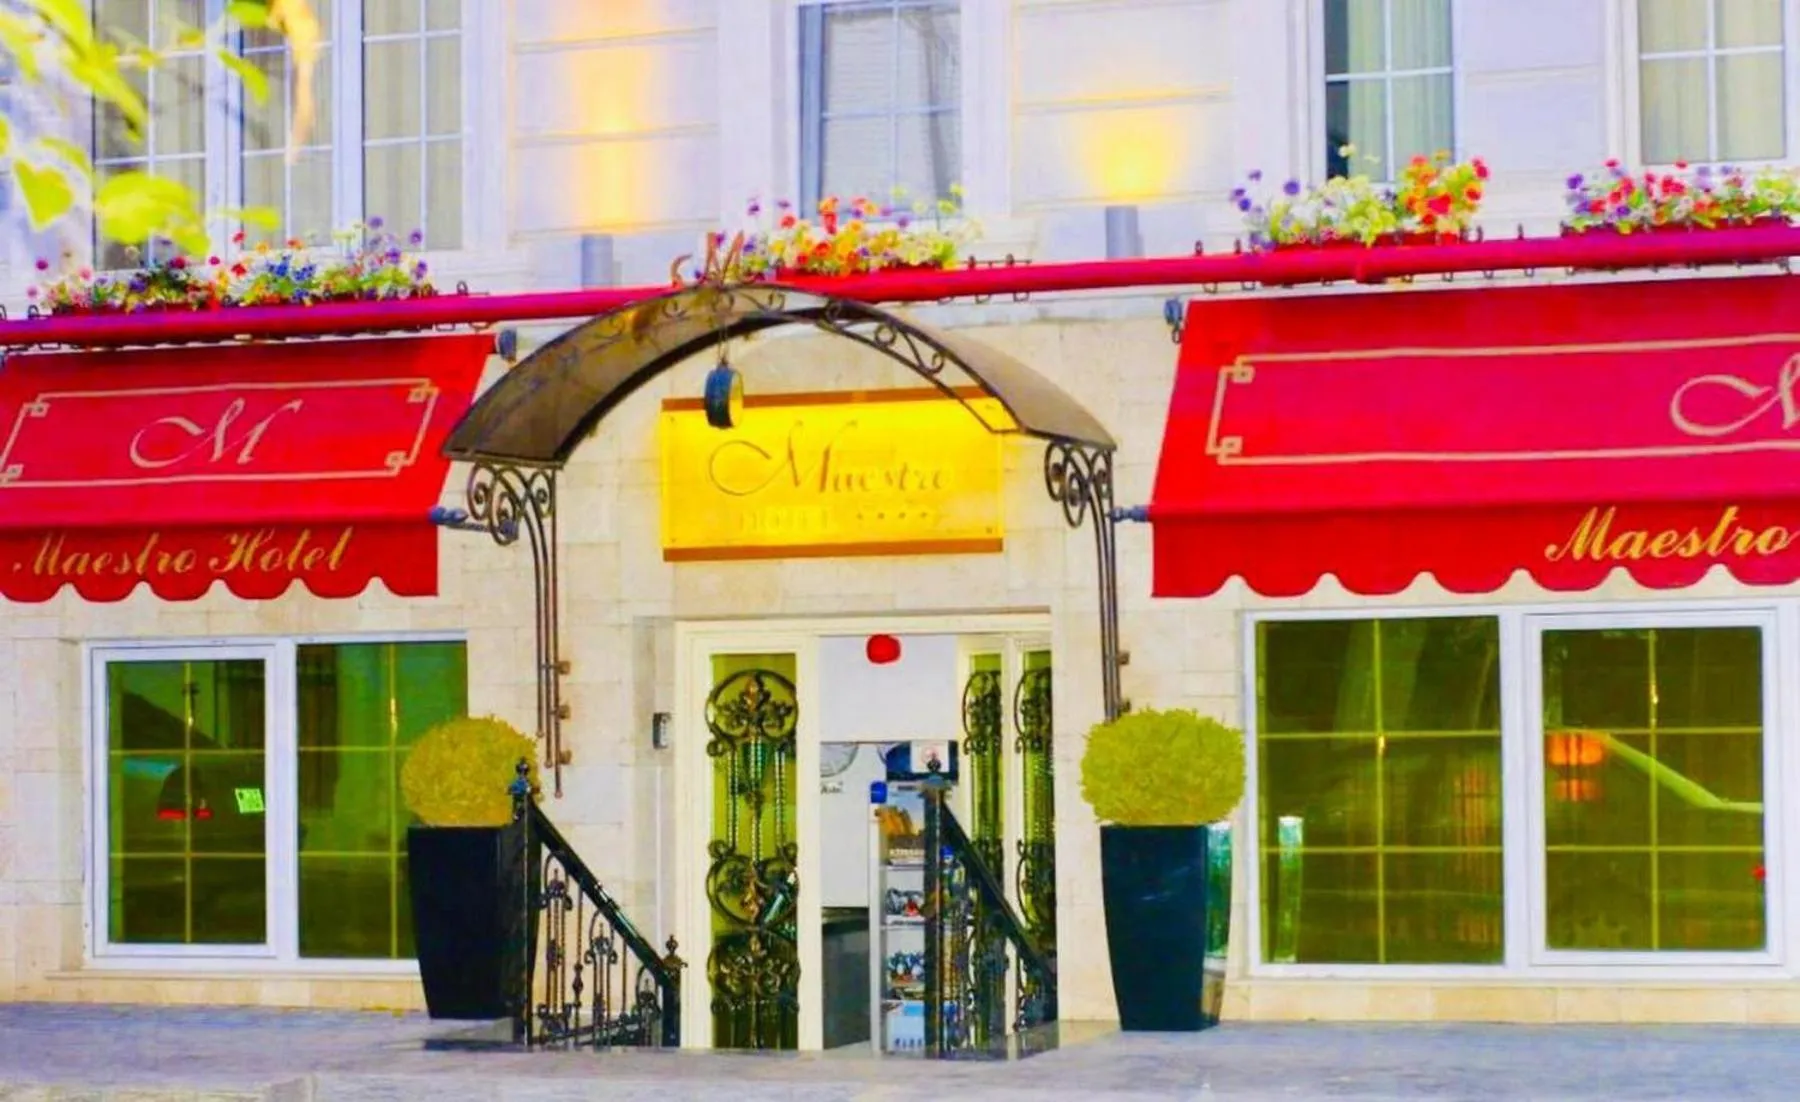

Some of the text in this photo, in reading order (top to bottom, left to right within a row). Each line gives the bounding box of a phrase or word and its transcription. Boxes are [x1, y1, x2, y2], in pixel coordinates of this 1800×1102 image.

[129, 397, 302, 469] M
[708, 420, 952, 497] Maestro
[12, 526, 354, 576] Maestro Hotel
[1544, 504, 1797, 562] Maestro
